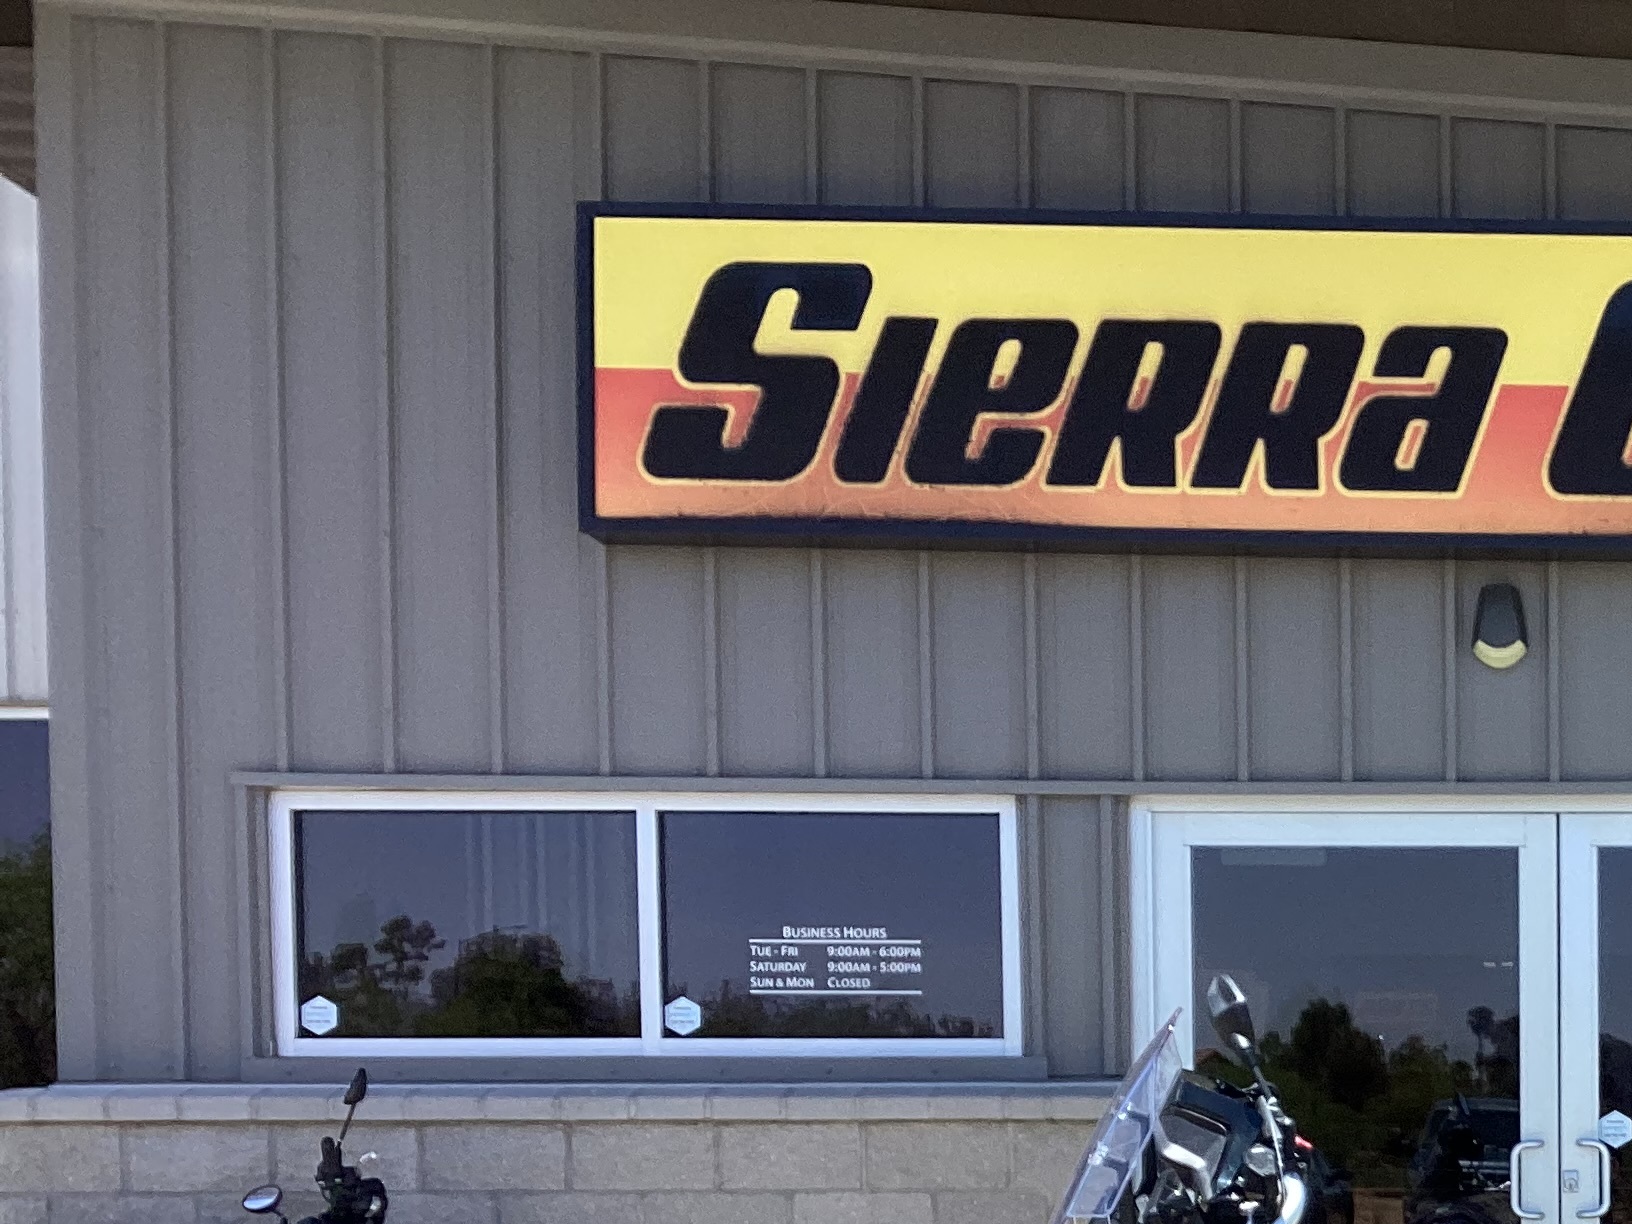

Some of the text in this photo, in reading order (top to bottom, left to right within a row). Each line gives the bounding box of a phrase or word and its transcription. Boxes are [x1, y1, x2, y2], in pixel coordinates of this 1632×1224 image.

[827, 946, 870, 957] 9:00AM
[879, 946, 921, 957] 6:00PM
[827, 962, 870, 973] 9:00AM
[880, 962, 921, 973] 5:00PM
[775, 978, 785, 988] &
